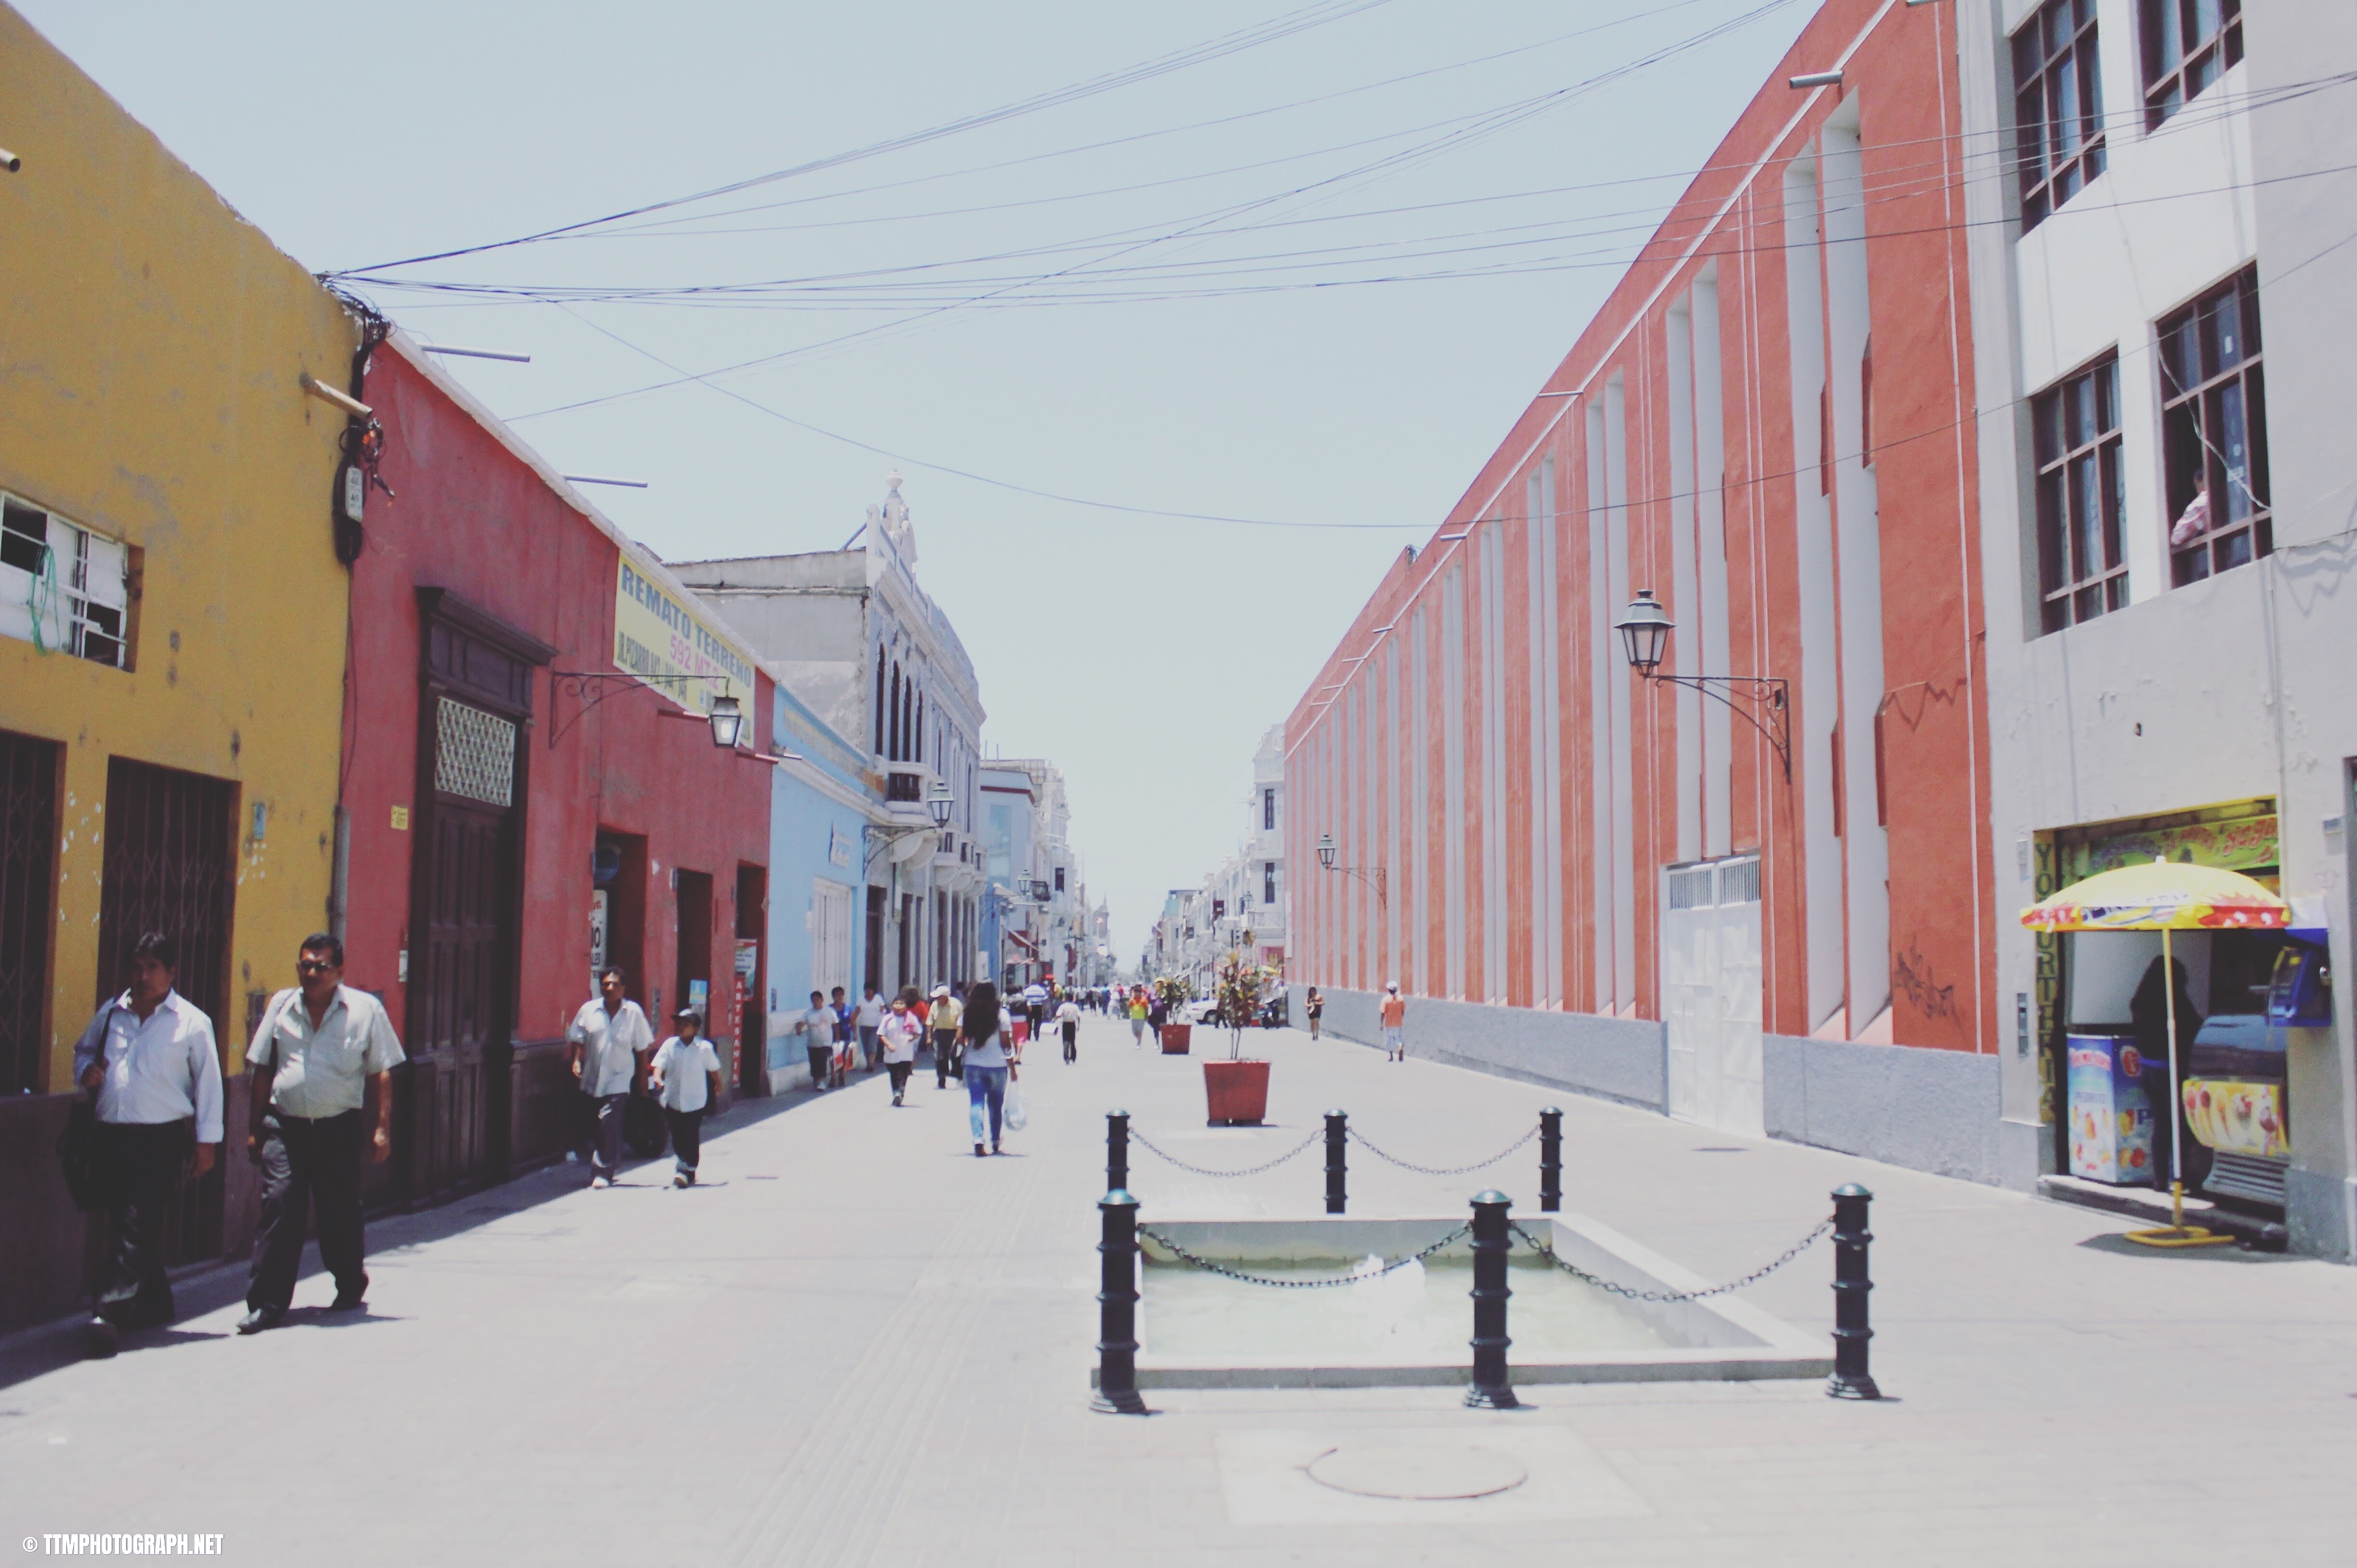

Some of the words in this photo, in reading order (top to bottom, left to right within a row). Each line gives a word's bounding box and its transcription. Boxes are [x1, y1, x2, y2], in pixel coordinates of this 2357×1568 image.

[621, 563, 691, 640] REMATO
[695, 623, 751, 688] TERRENO
[670, 634, 691, 671] 592
[2034, 843, 2055, 1106] YOURTERIA
